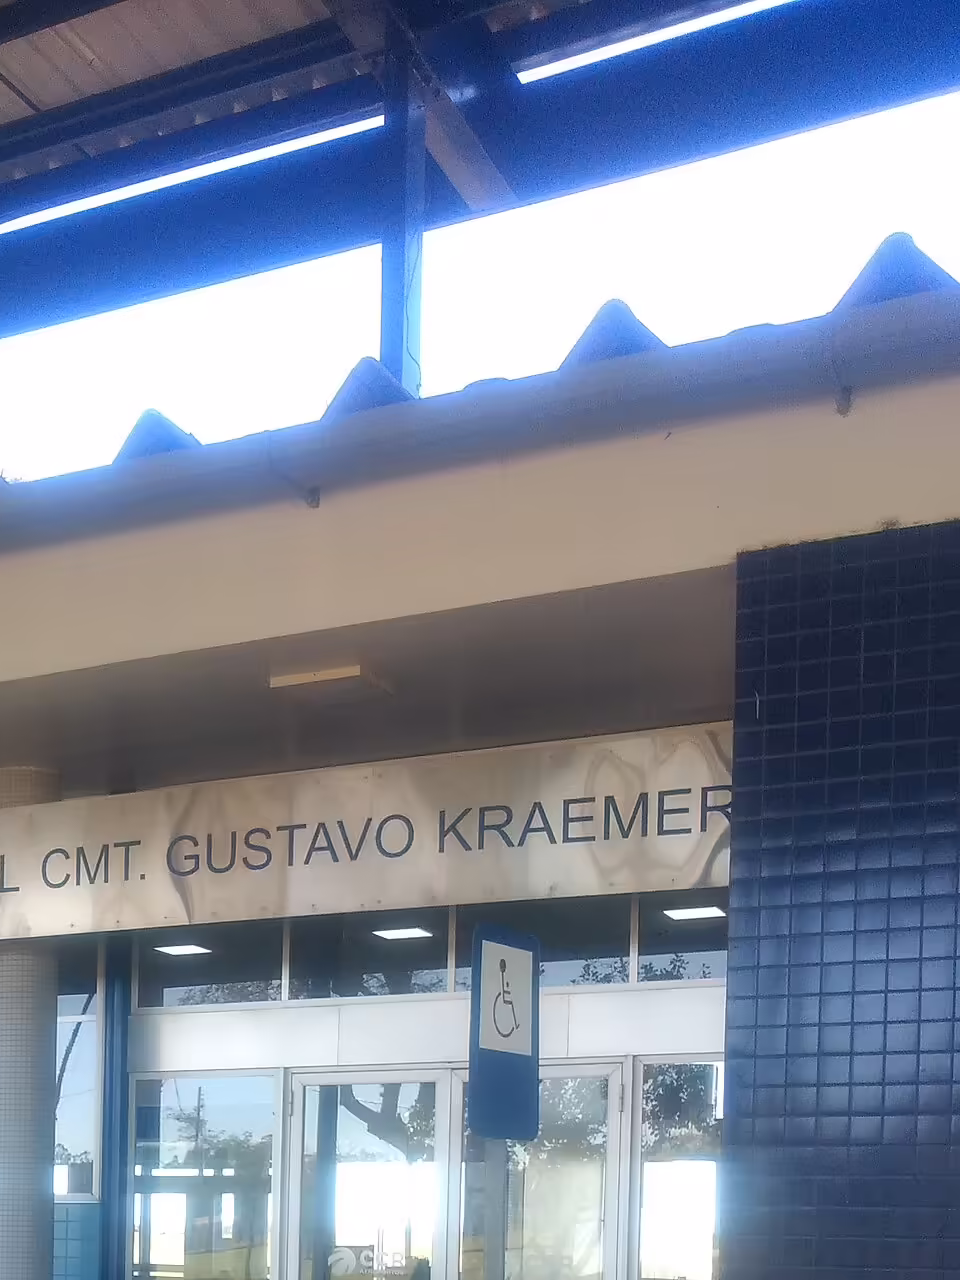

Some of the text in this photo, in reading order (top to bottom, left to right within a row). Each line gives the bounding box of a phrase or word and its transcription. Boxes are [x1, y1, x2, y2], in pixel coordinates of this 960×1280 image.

[41, 839, 147, 889] CMT.
[166, 813, 415, 877] GUSTAVO
[438, 784, 733, 855] KRAEMER
